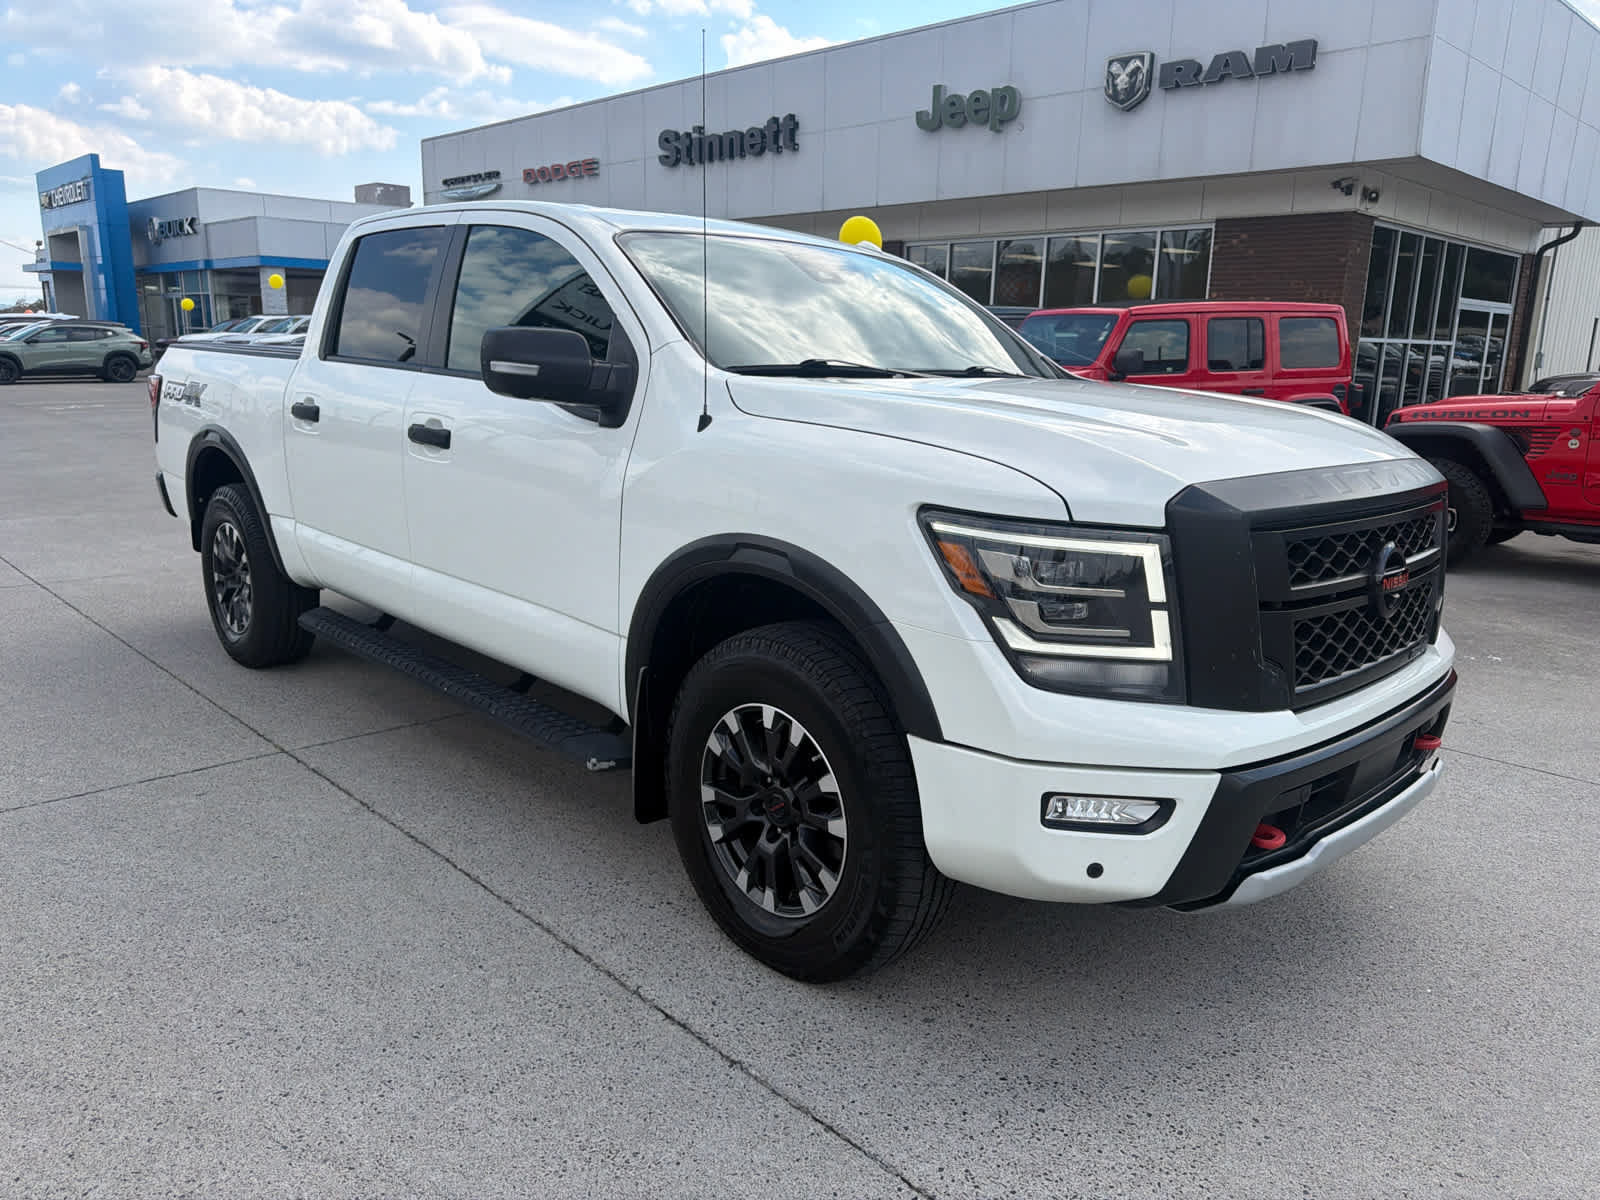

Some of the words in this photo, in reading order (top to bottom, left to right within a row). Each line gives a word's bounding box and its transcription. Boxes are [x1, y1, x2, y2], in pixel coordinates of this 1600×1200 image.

[1158, 39, 1318, 89] RAM
[915, 84, 1022, 133] Jeep
[658, 113, 800, 168] Stinnett
[522, 158, 599, 184] DODGE
[159, 216, 197, 238] BUICK
[1412, 410, 1529, 419] RUBICON
